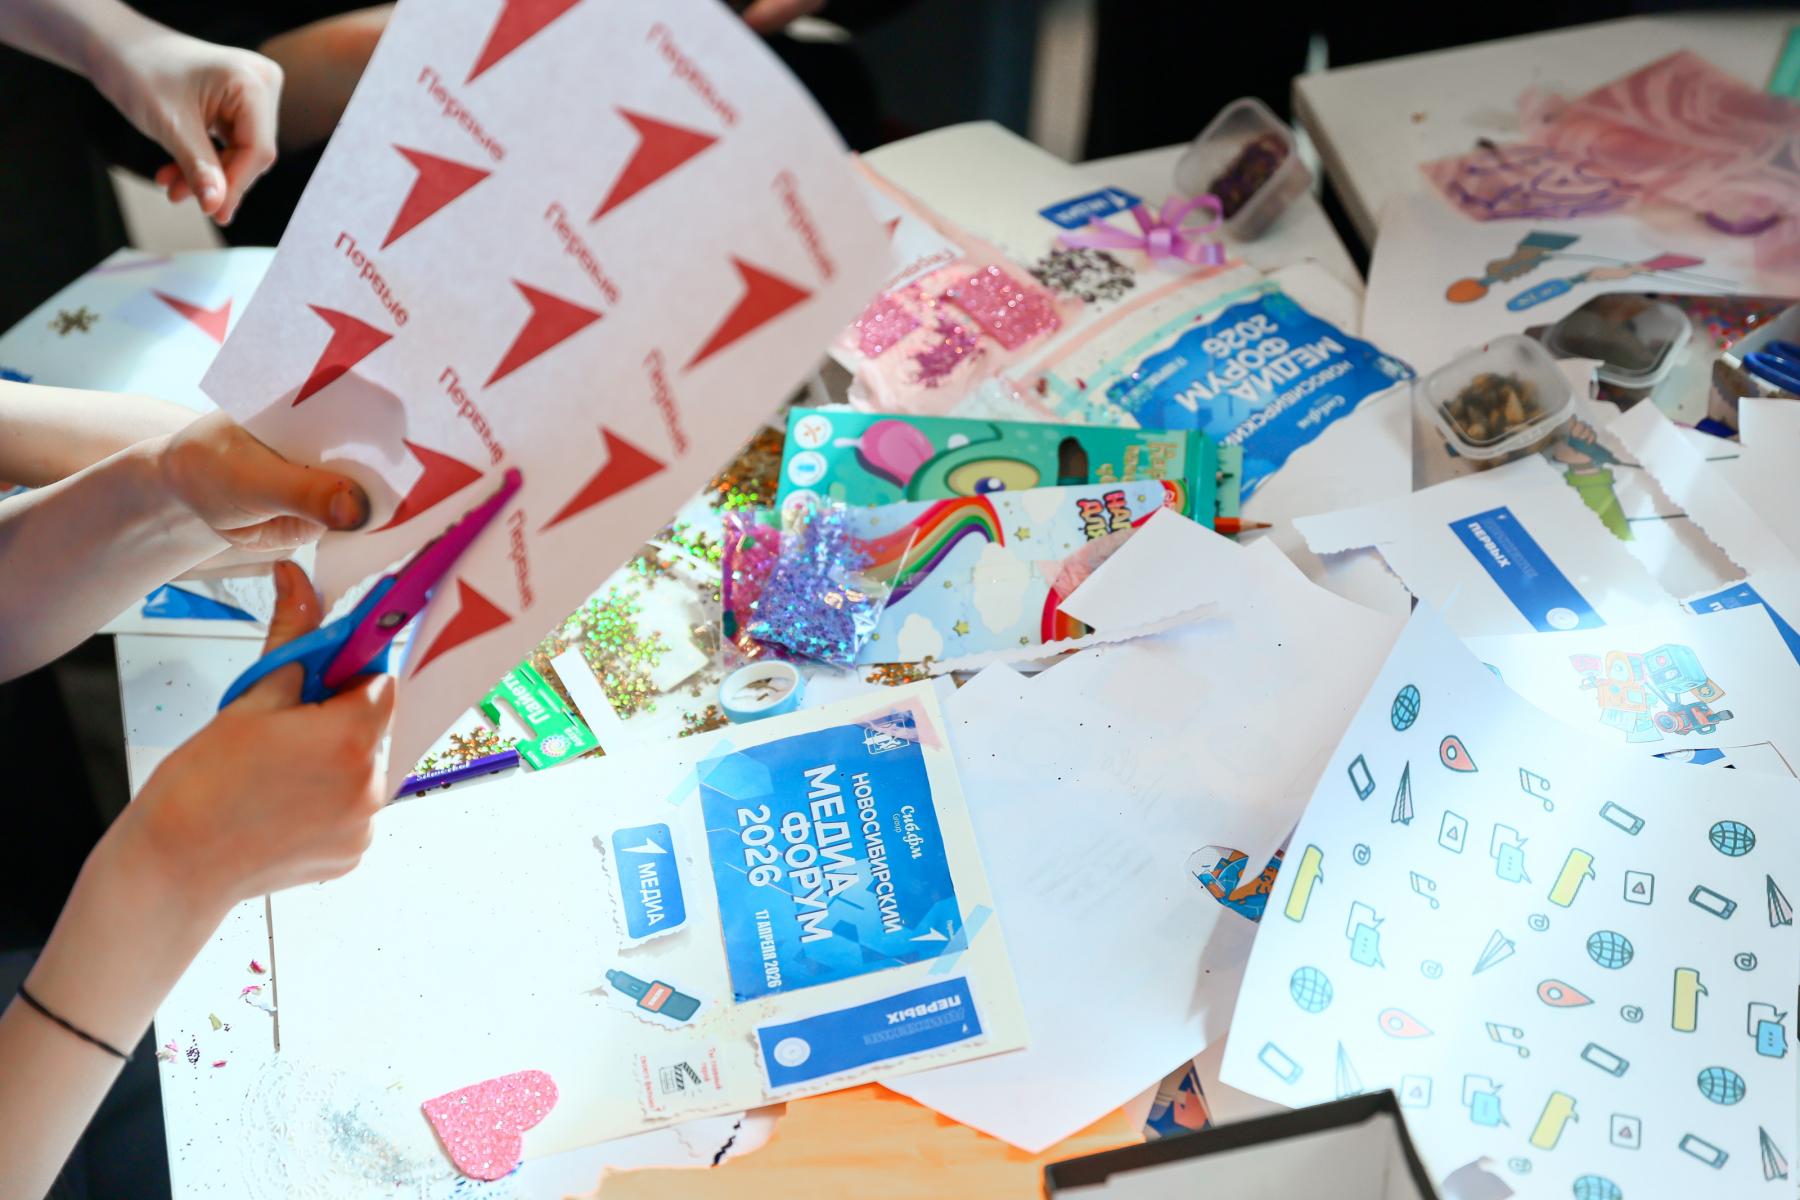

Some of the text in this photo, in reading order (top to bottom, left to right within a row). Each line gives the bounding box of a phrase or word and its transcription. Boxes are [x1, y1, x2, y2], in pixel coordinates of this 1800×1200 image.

[334, 231, 409, 327] Первые
[1174, 337, 1289, 413] ФОРУМ
[1201, 314, 1279, 358] 2026
[1228, 336, 1347, 402] МЕДИА
[439, 367, 504, 465] Первые
[1219, 360, 1354, 447] НОВОСИБИРСКИ
[1467, 520, 1511, 568] ПЕРВЫХ
[737, 804, 782, 886] 2026
[804, 764, 859, 897] МЕДИА
[852, 772, 904, 934] НОВОСИБИРСКИЙ
[636, 861, 666, 926] МЕДИА
[780, 812, 833, 944] ФОРУМ
[755, 909, 782, 988] 17 АПРЕЛЯ 2026
[886, 994, 963, 1025] ПЕРВЫХ
